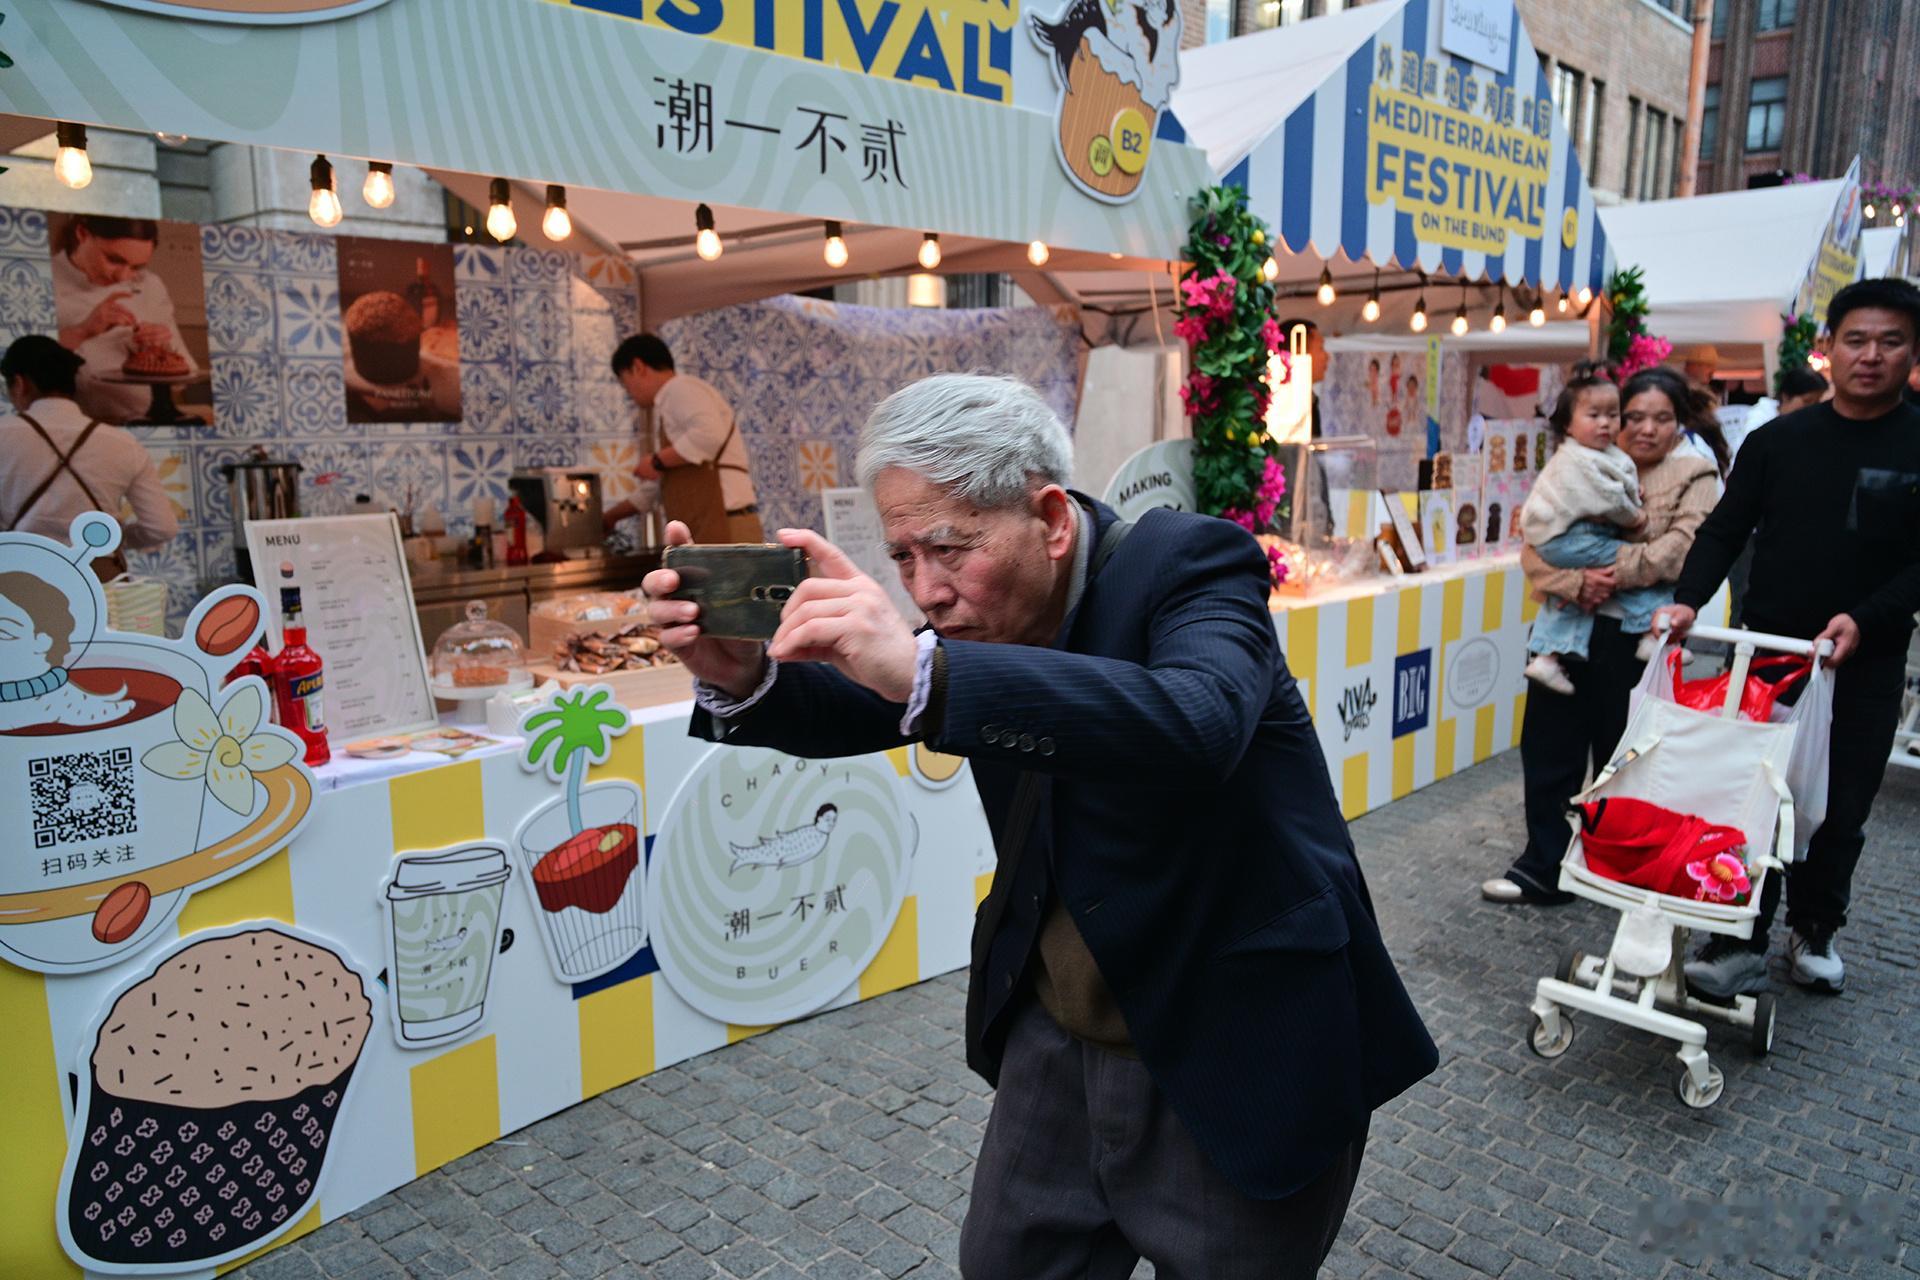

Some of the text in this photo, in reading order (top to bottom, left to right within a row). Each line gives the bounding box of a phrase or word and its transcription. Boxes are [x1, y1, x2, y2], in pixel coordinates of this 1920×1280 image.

[570, 0, 1003, 102] TIVAL
[653, 76, 909, 189] 潮一不贰
[1121, 128, 1143, 154] B2
[1374, 96, 1550, 172] MEDITERRANEAN
[1375, 141, 1543, 228] FESTIVAL
[1421, 212, 1506, 245] ON THE BUND
[1119, 471, 1173, 505] MAKING
[265, 535, 301, 547] MENU
[1397, 665, 1426, 723] BIG
[41, 844, 136, 877] 扫码关注
[723, 883, 848, 942] 潮一不贰
